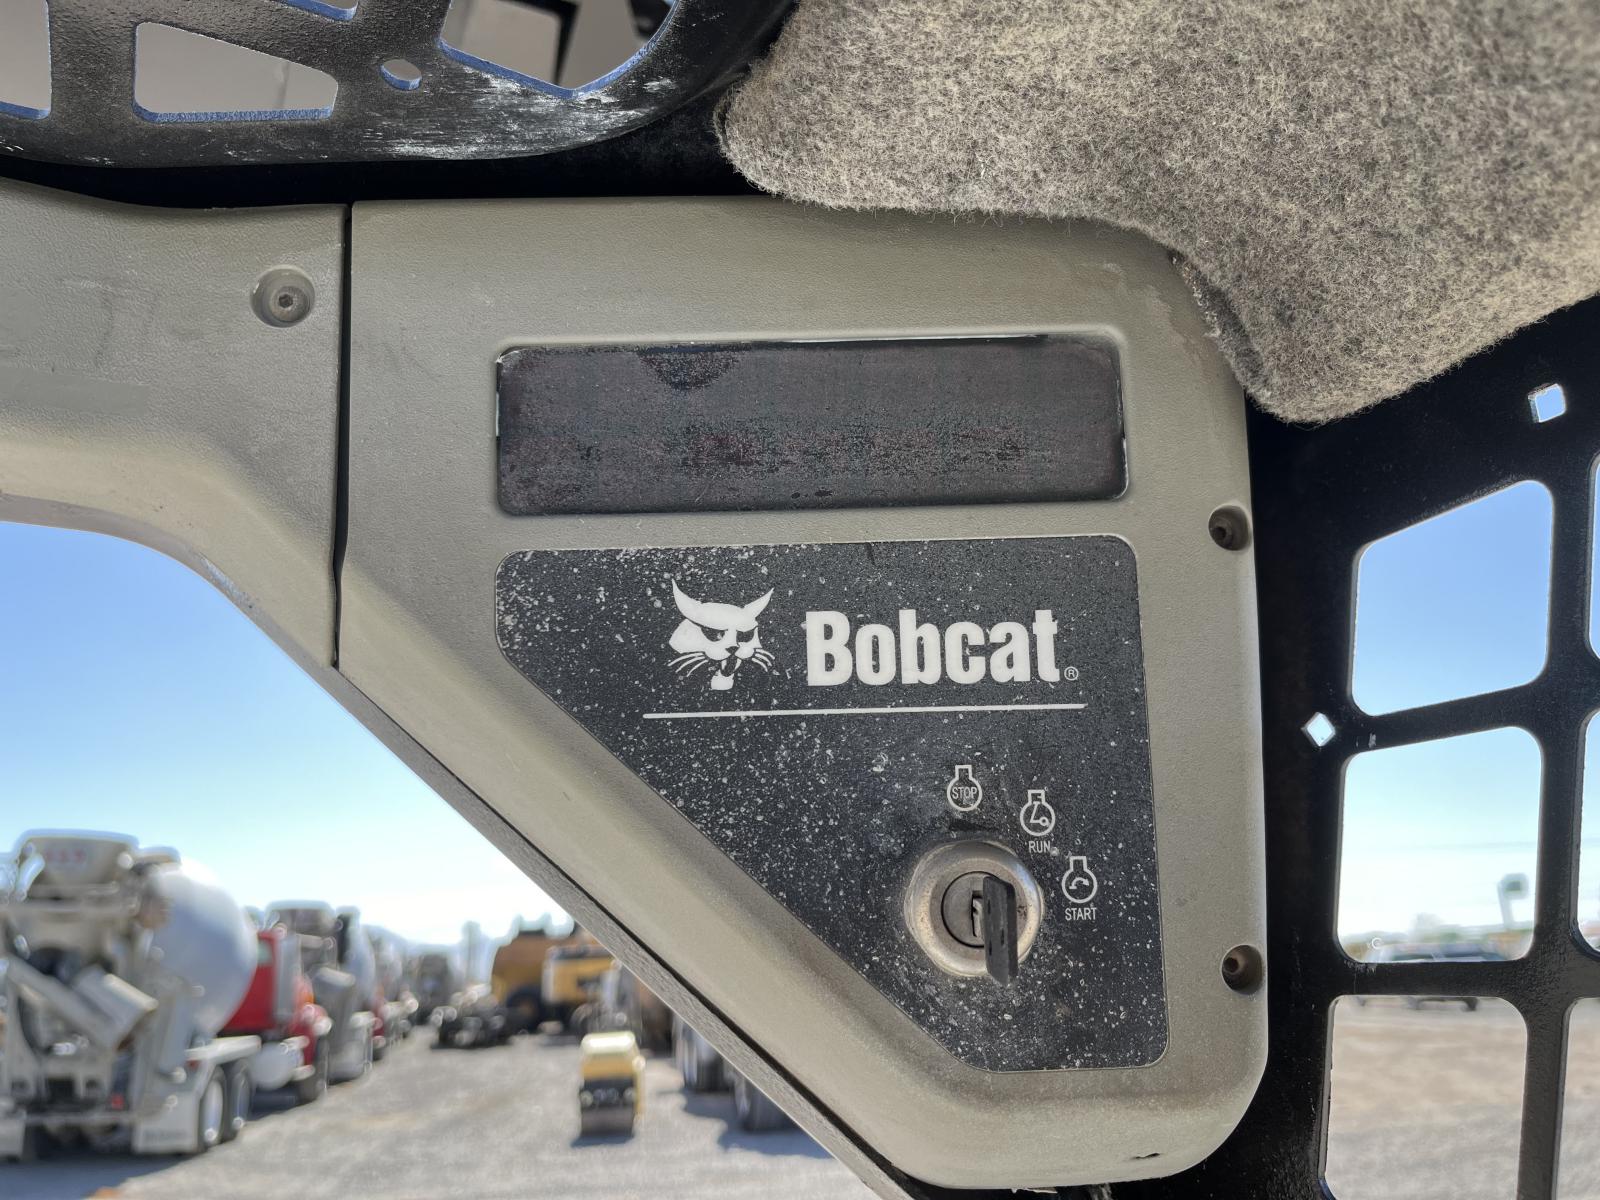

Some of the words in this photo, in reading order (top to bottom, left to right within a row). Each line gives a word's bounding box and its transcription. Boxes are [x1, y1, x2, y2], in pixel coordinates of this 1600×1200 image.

[951, 786, 978, 800] STOP
[1028, 840, 1051, 853] RUN
[1064, 907, 1097, 921] START
